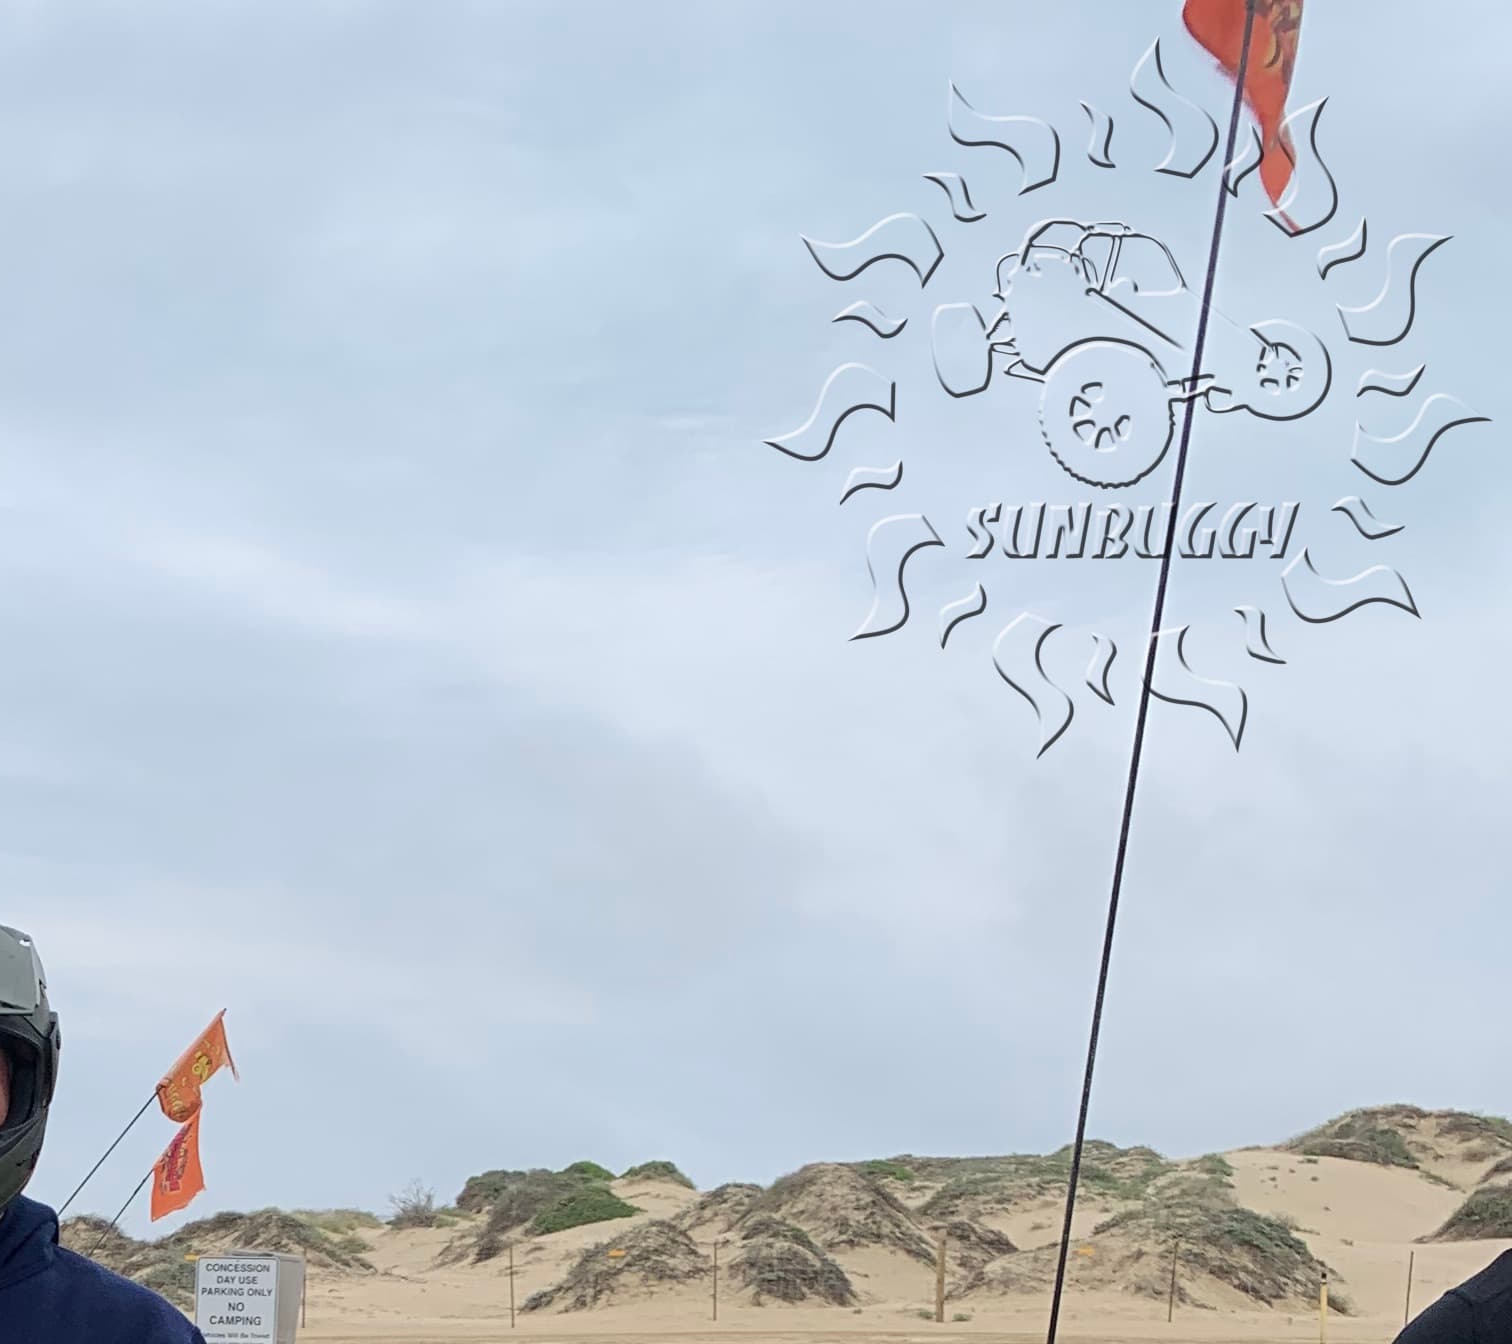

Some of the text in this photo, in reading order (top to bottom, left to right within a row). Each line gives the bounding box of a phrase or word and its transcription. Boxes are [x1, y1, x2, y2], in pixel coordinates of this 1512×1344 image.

[205, 1263, 271, 1273] CONCESSION
[216, 1275, 258, 1285] DAY USE
[201, 1287, 273, 1297] PARKING ONLY
[227, 1302, 245, 1312] NO
[209, 1315, 262, 1326] CAMPING
